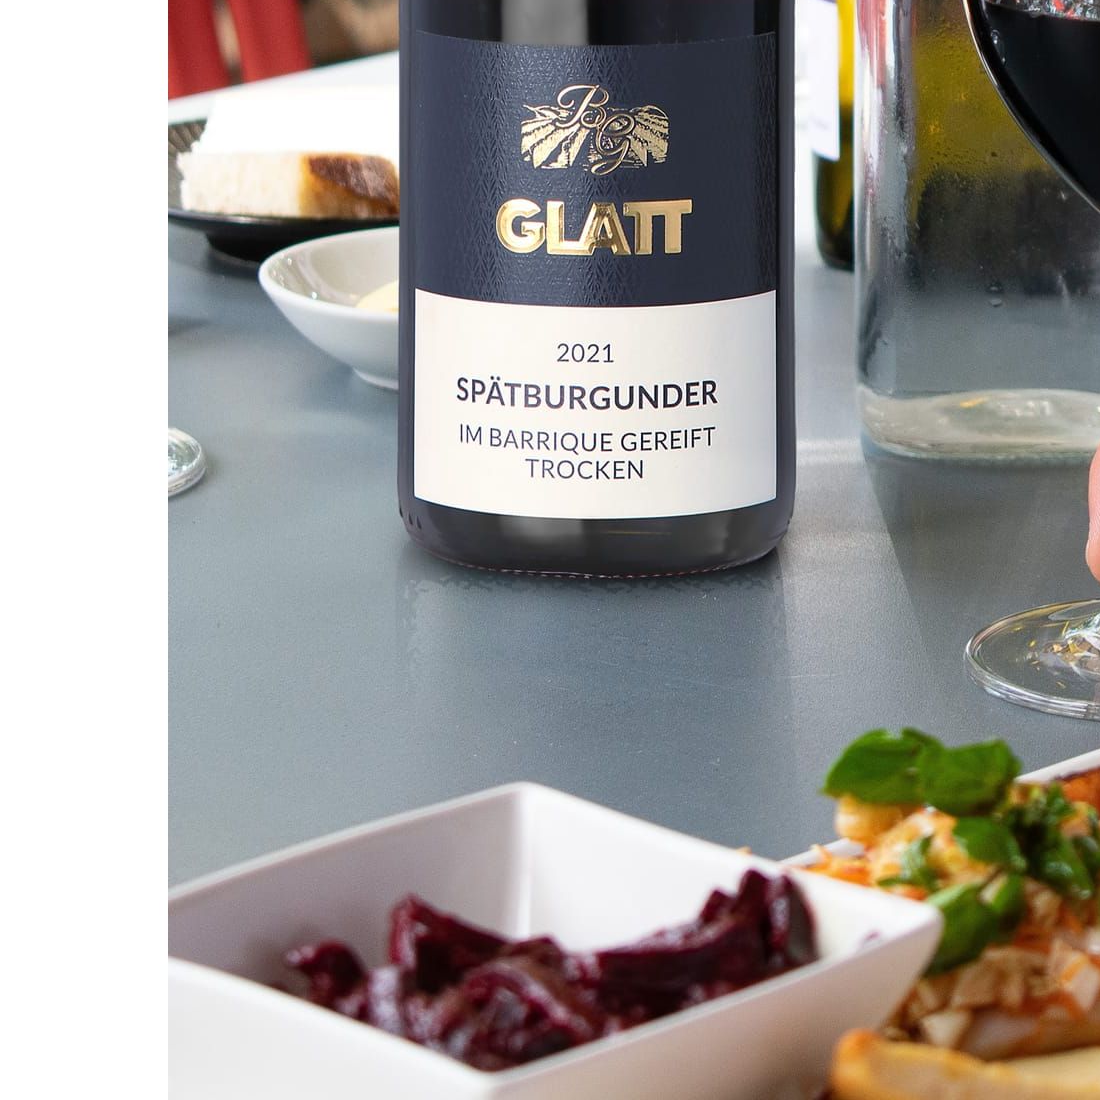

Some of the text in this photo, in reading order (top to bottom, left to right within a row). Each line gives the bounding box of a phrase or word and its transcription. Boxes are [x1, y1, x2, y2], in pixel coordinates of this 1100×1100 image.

[495, 198, 694, 256] GLATT
[556, 343, 615, 363] 2021
[456, 375, 719, 411] SPÄTBURGUNDER
[460, 423, 716, 456] IM BARRIQUE GEREIFT
[525, 458, 644, 480] TROCKEN
